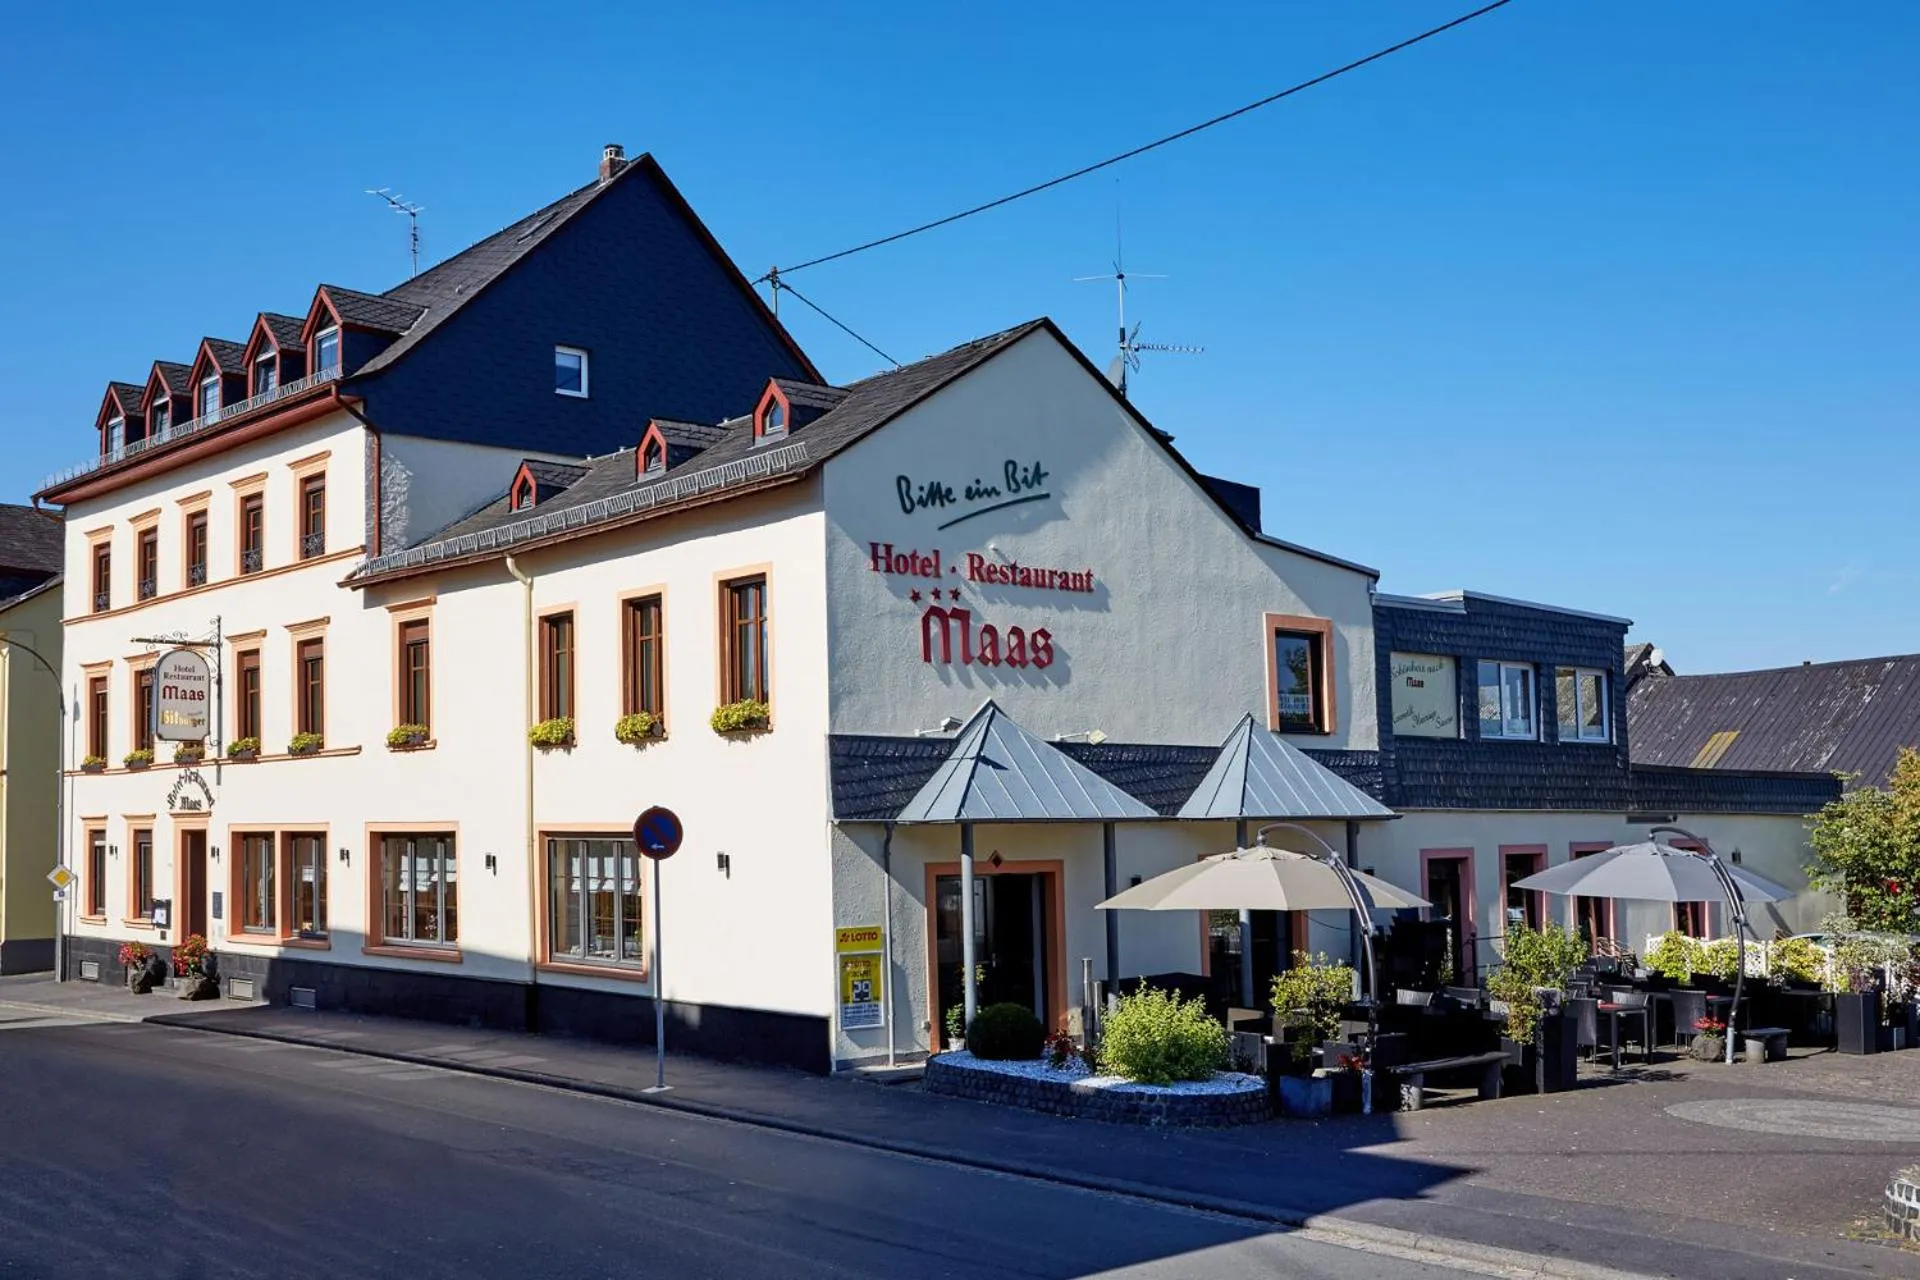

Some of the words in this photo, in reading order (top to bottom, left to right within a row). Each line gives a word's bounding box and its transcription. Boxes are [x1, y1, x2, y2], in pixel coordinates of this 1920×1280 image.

[896, 474, 956, 514] Bitte
[964, 478, 1001, 501] ein
[1004, 459, 1050, 493] Bit
[868, 542, 943, 579] Hotel
[966, 552, 1095, 594] Restaurant
[920, 604, 1055, 670] Maas
[173, 664, 196, 673] Hotel
[163, 672, 205, 682] Restaurant
[162, 685, 205, 701] Maas
[851, 931, 878, 942] LOTTO
